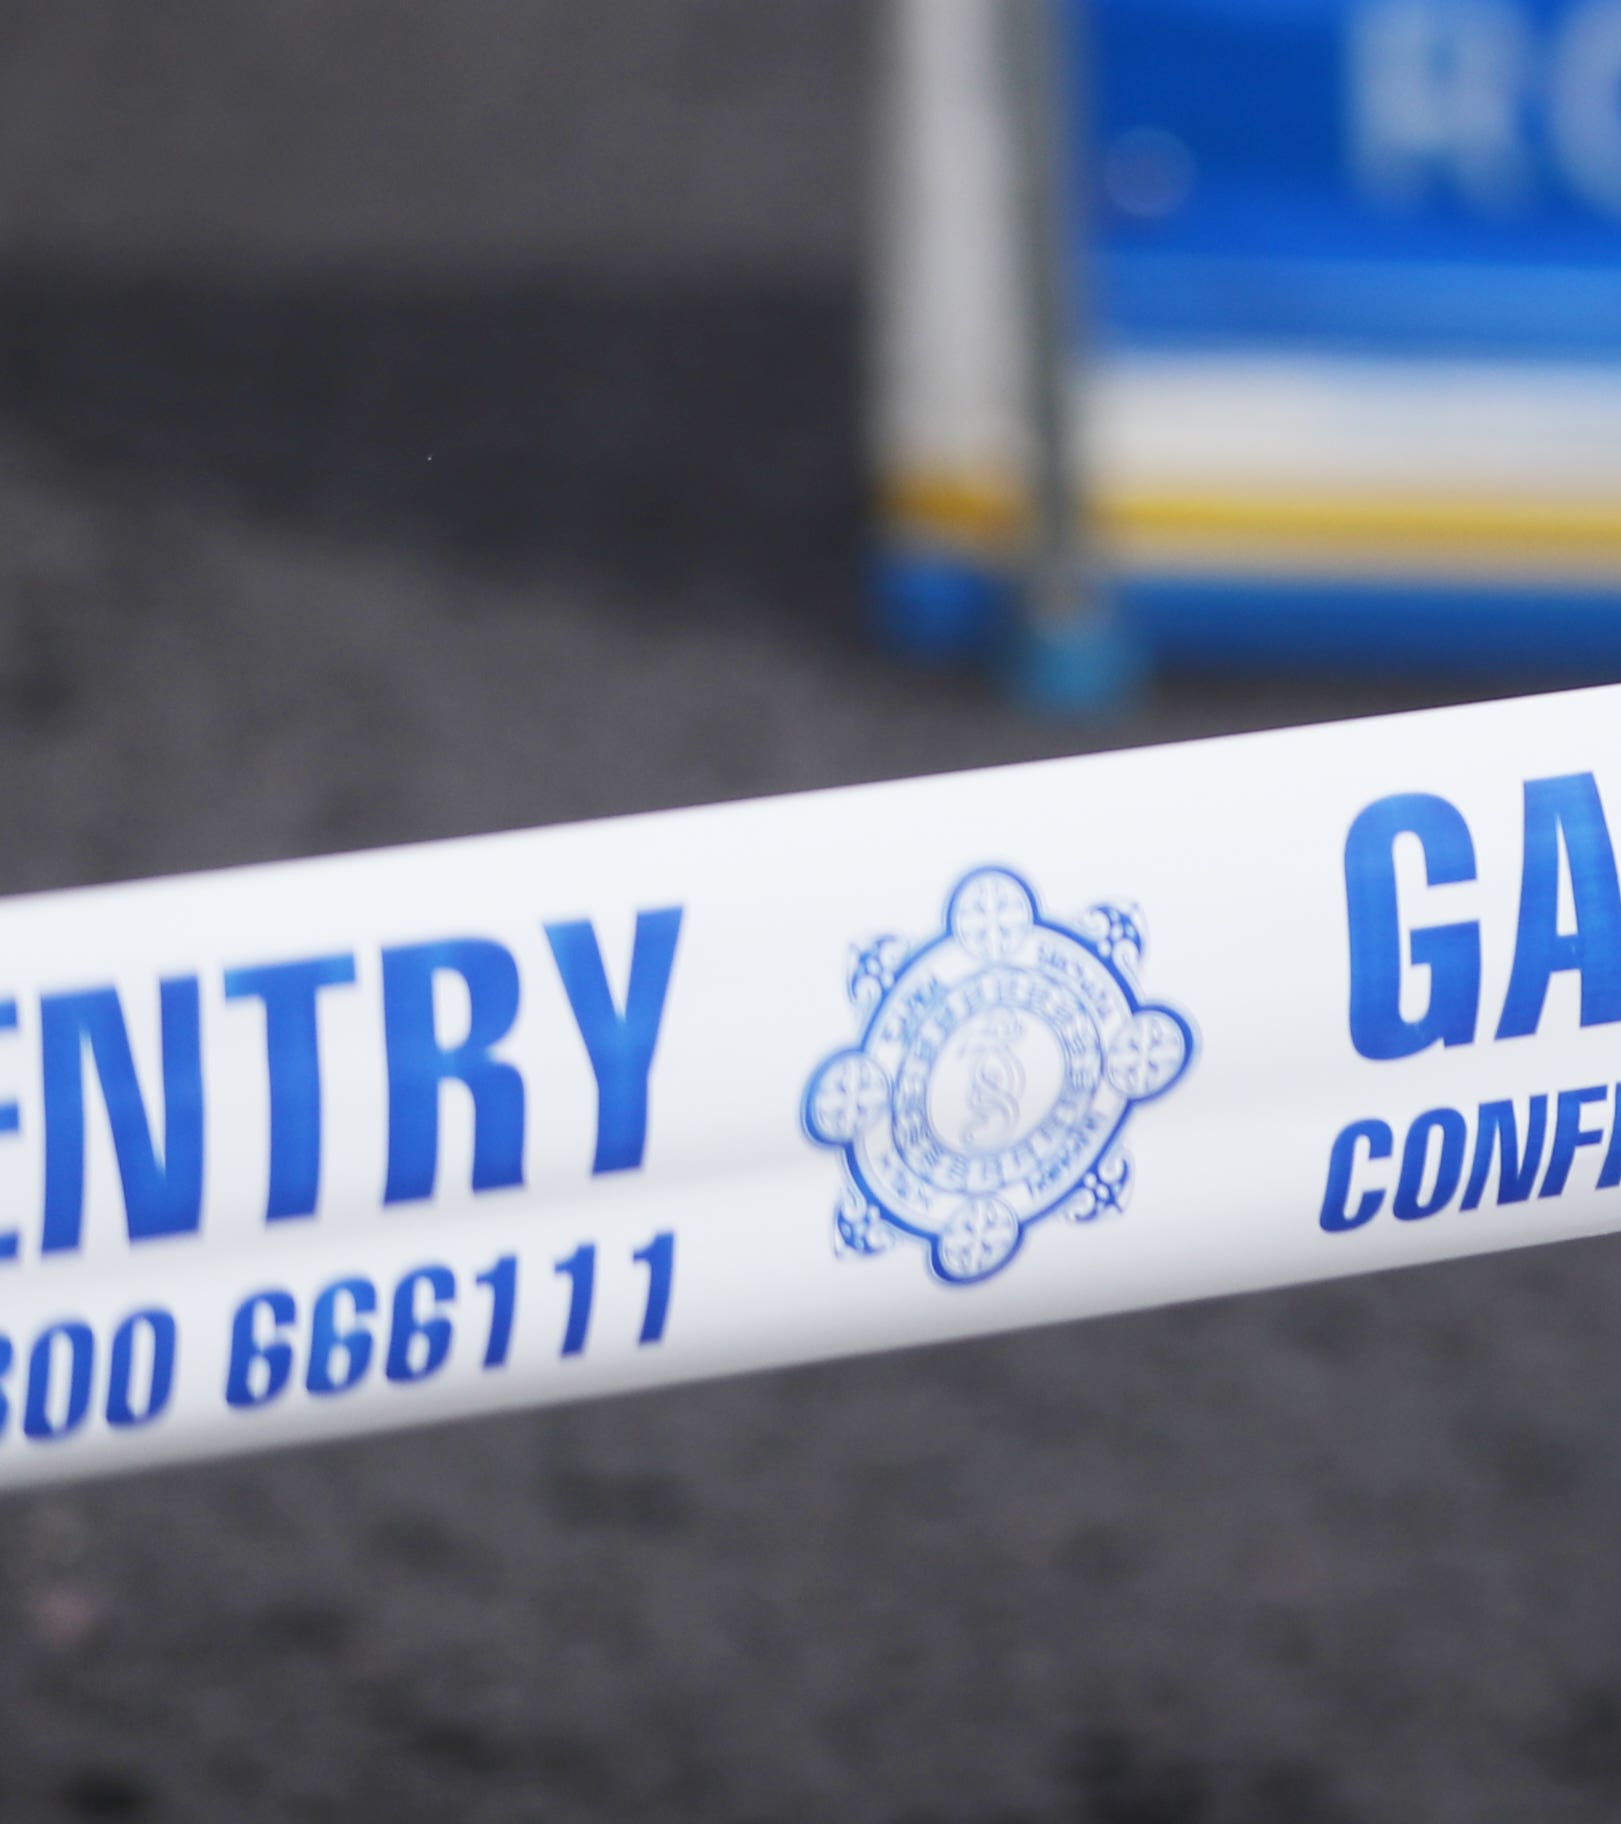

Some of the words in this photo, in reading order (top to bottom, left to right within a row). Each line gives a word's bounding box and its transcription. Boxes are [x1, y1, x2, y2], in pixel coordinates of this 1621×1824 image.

[0, 905, 684, 1261] NTRY
[0, 1307, 178, 1441] 00
[224, 1232, 676, 1409] 666111
